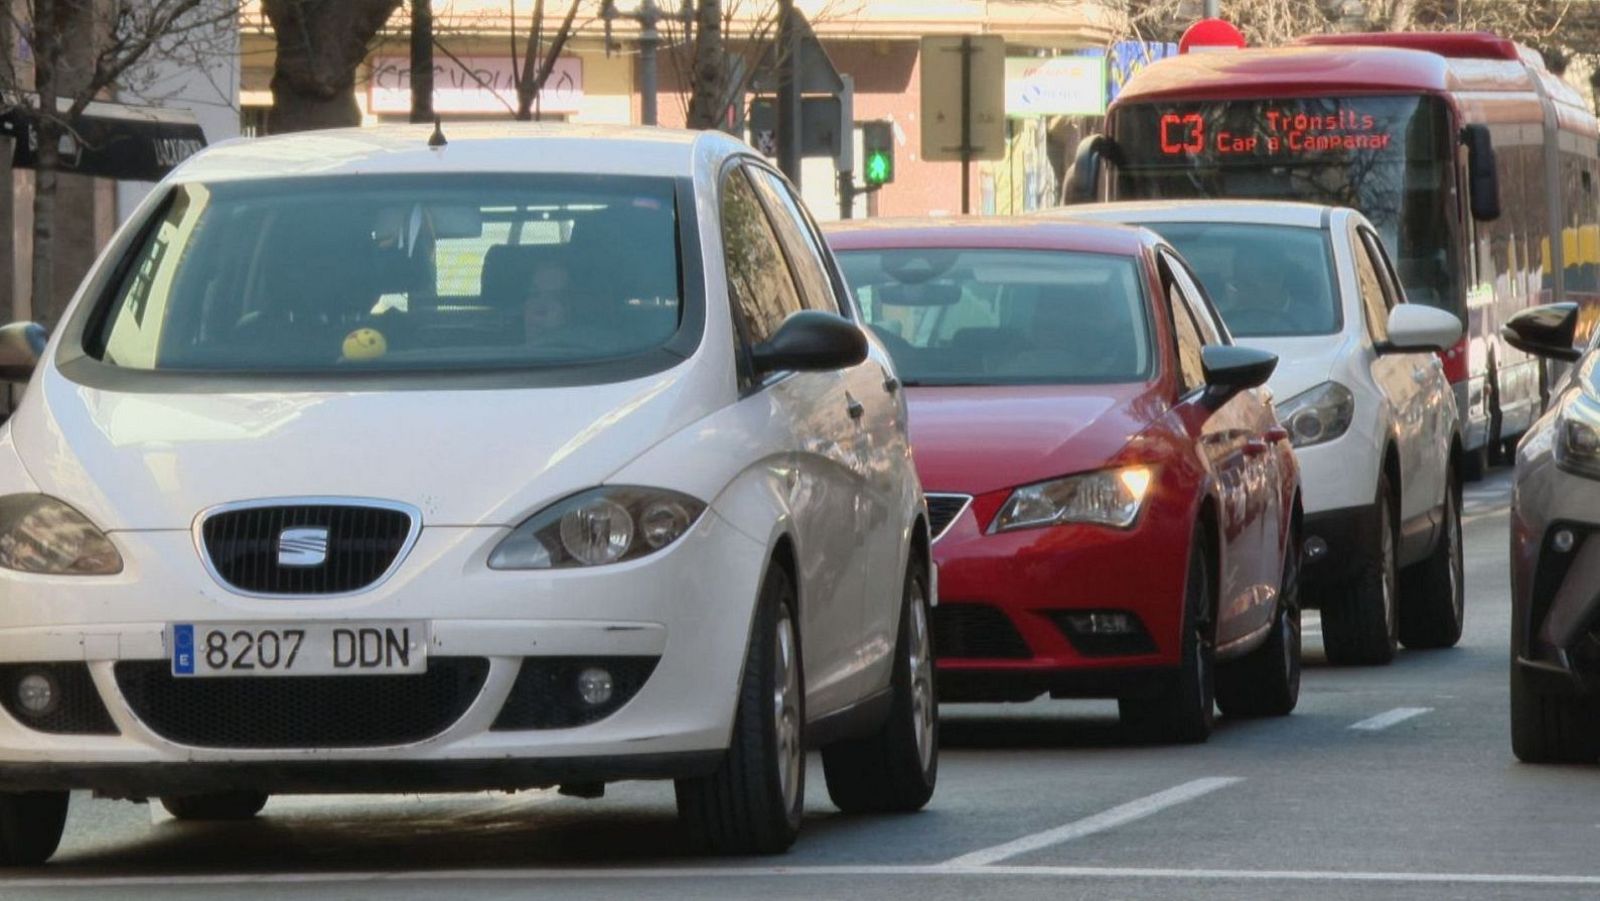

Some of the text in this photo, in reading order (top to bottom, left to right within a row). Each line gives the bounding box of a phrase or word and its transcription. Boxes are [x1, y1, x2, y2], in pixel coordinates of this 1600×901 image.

[1161, 113, 1205, 153] C3
[1217, 133, 1257, 152] Cap
[1289, 131, 1391, 150] Campanar
[179, 654, 189, 666] E
[206, 628, 410, 669] 8207 DDN
